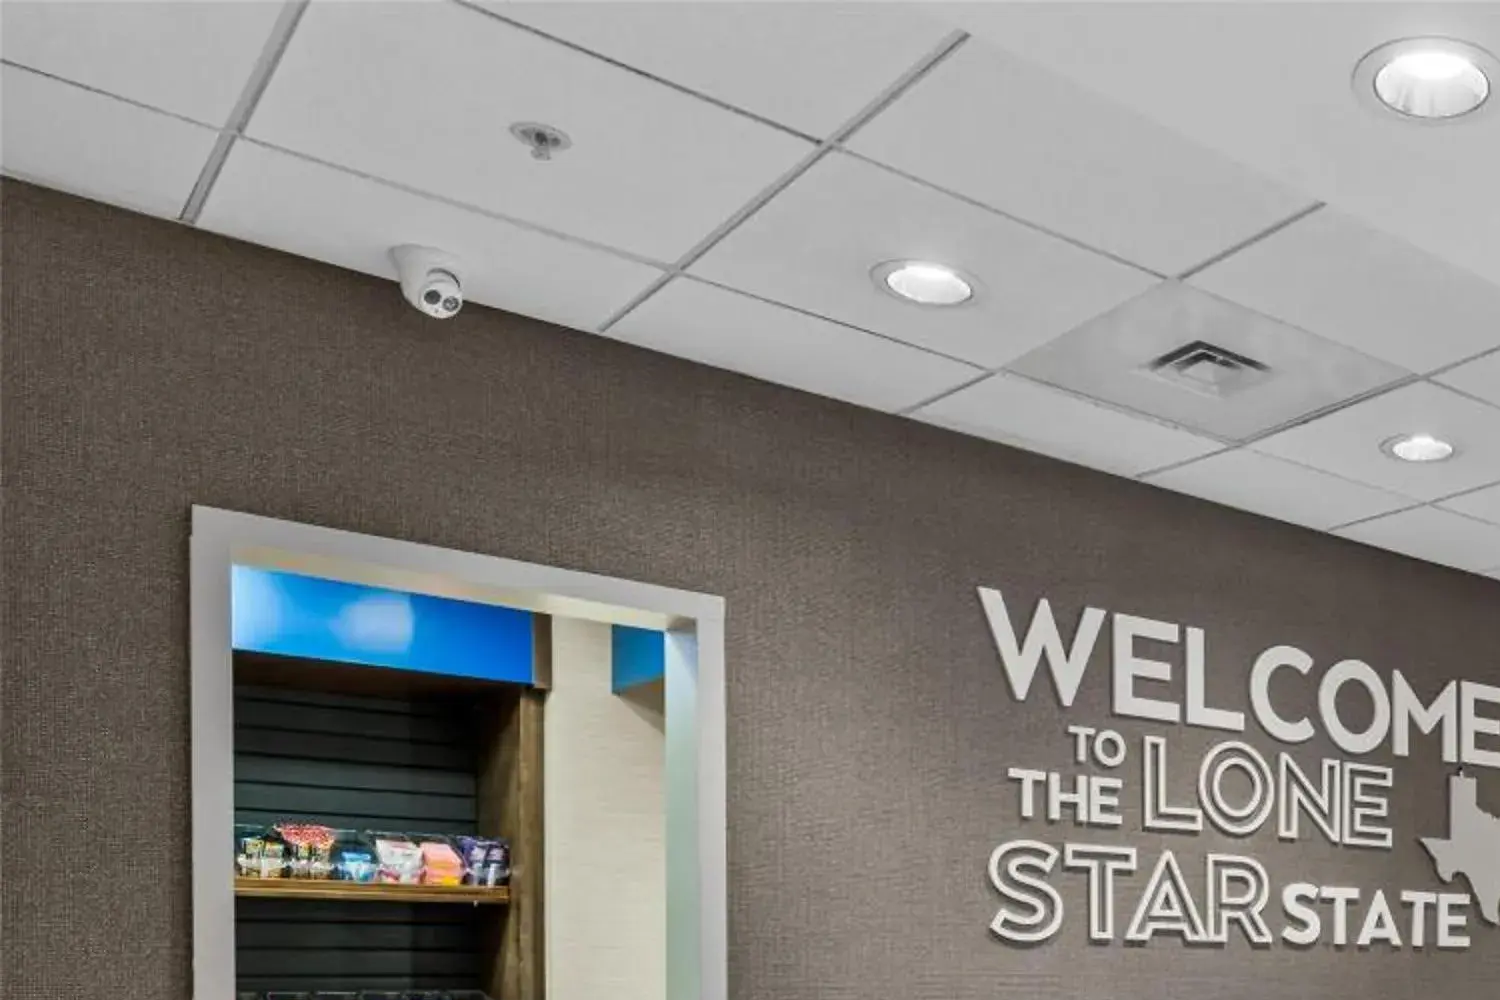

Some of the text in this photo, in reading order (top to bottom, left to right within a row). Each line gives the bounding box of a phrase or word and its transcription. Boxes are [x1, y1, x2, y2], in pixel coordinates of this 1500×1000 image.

[1007, 735, 1393, 849] THE LONE
[1068, 724, 1126, 767] TO
[987, 839, 1471, 947] STAR STATE
